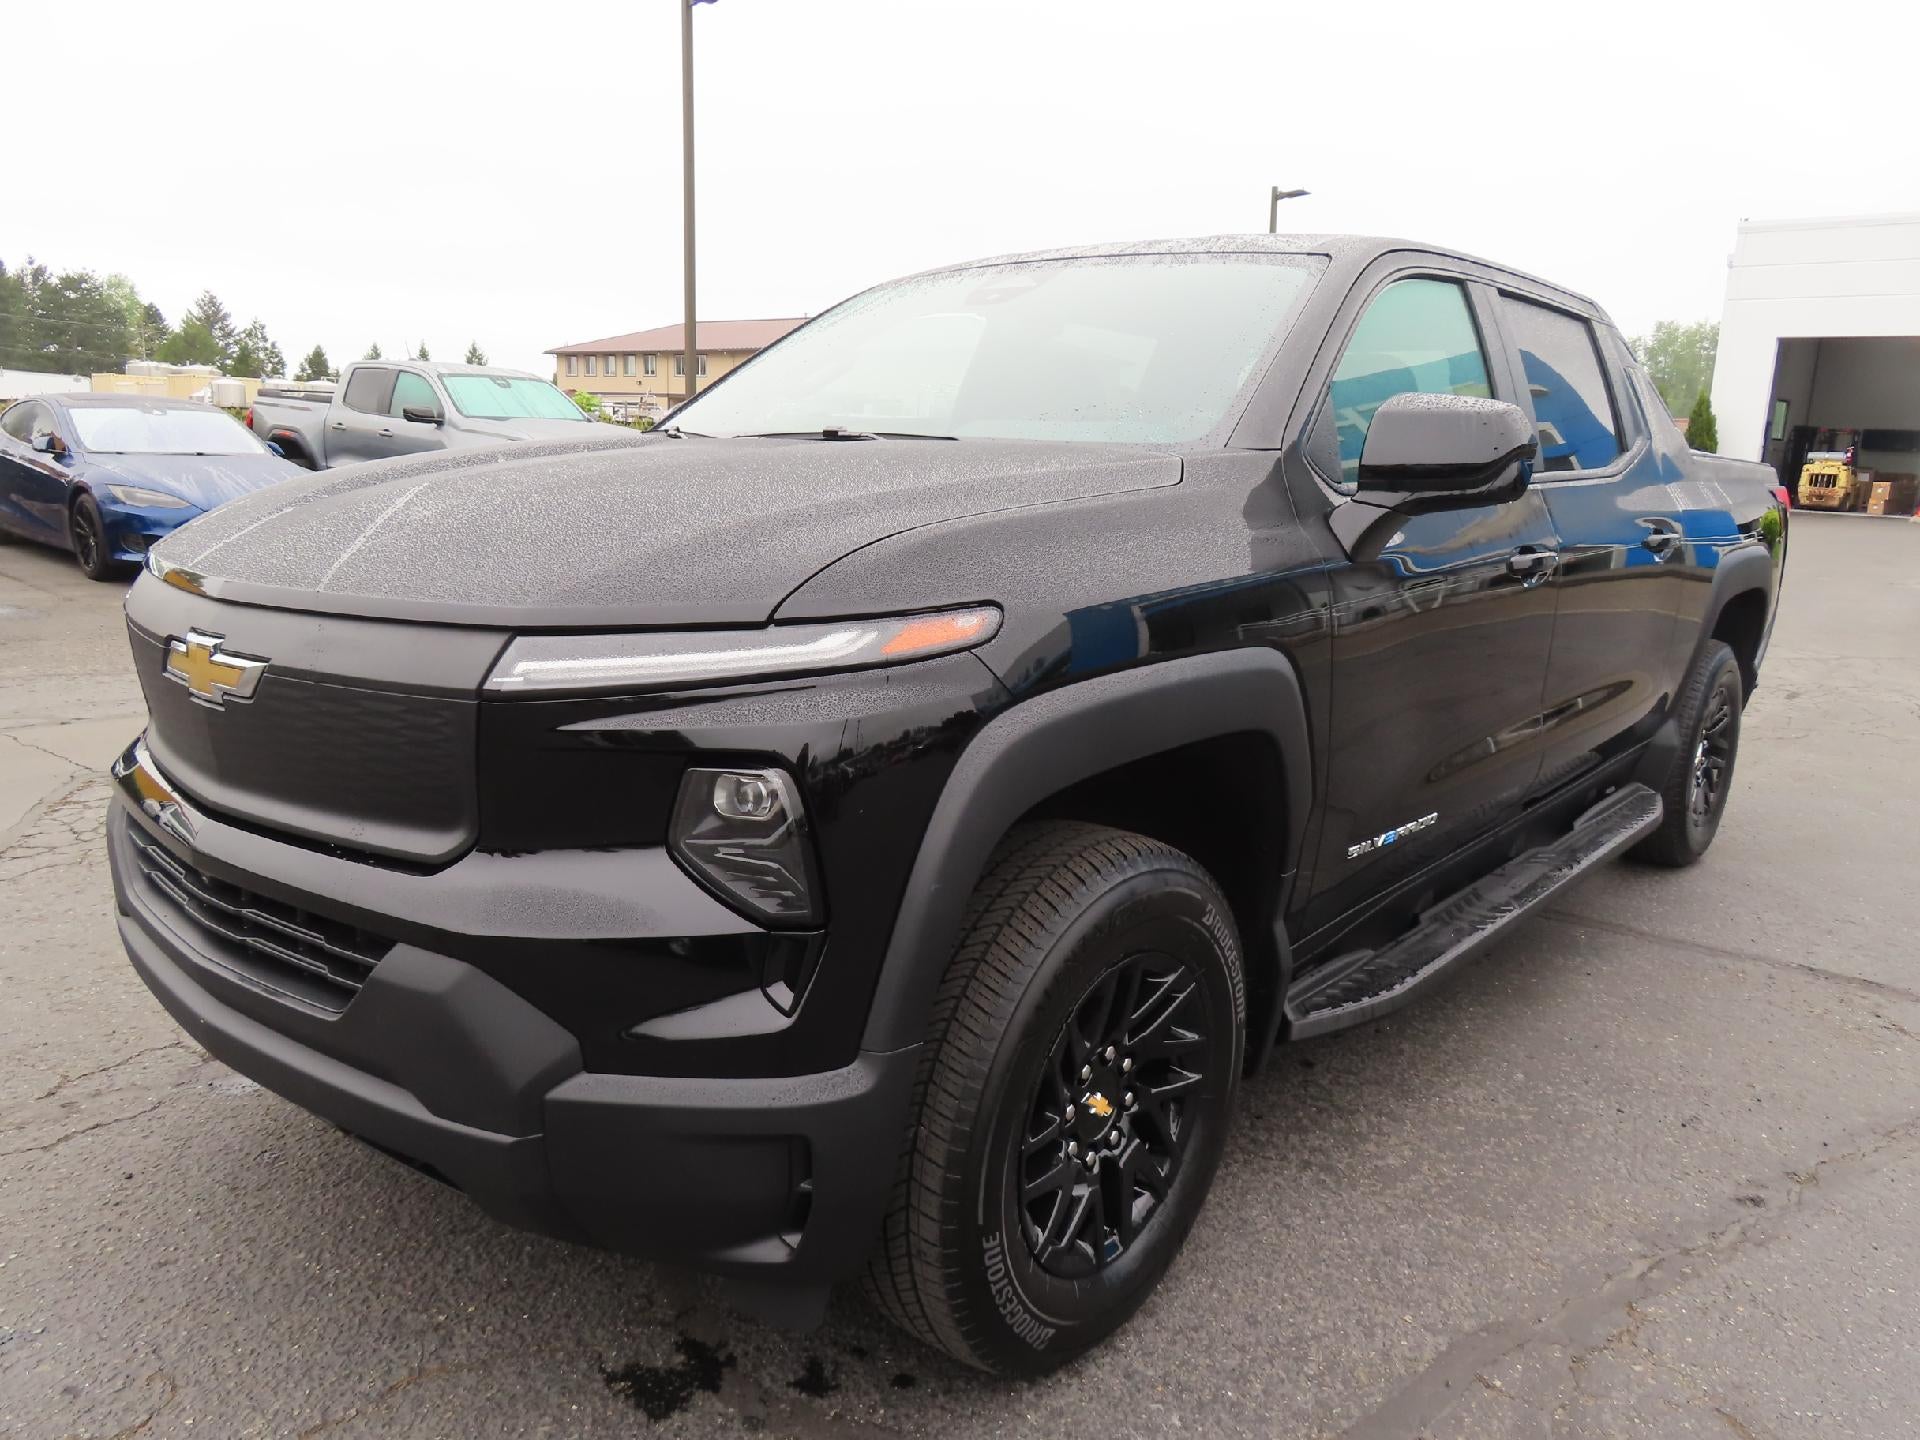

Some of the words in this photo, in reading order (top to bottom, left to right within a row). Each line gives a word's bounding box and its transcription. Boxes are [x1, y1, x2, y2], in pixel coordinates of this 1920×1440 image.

[1346, 812, 1438, 859] SILVERADO
[1201, 903, 1246, 1025] BRIDGESTONE
[982, 1231, 1056, 1350] BRIDGESTONE
